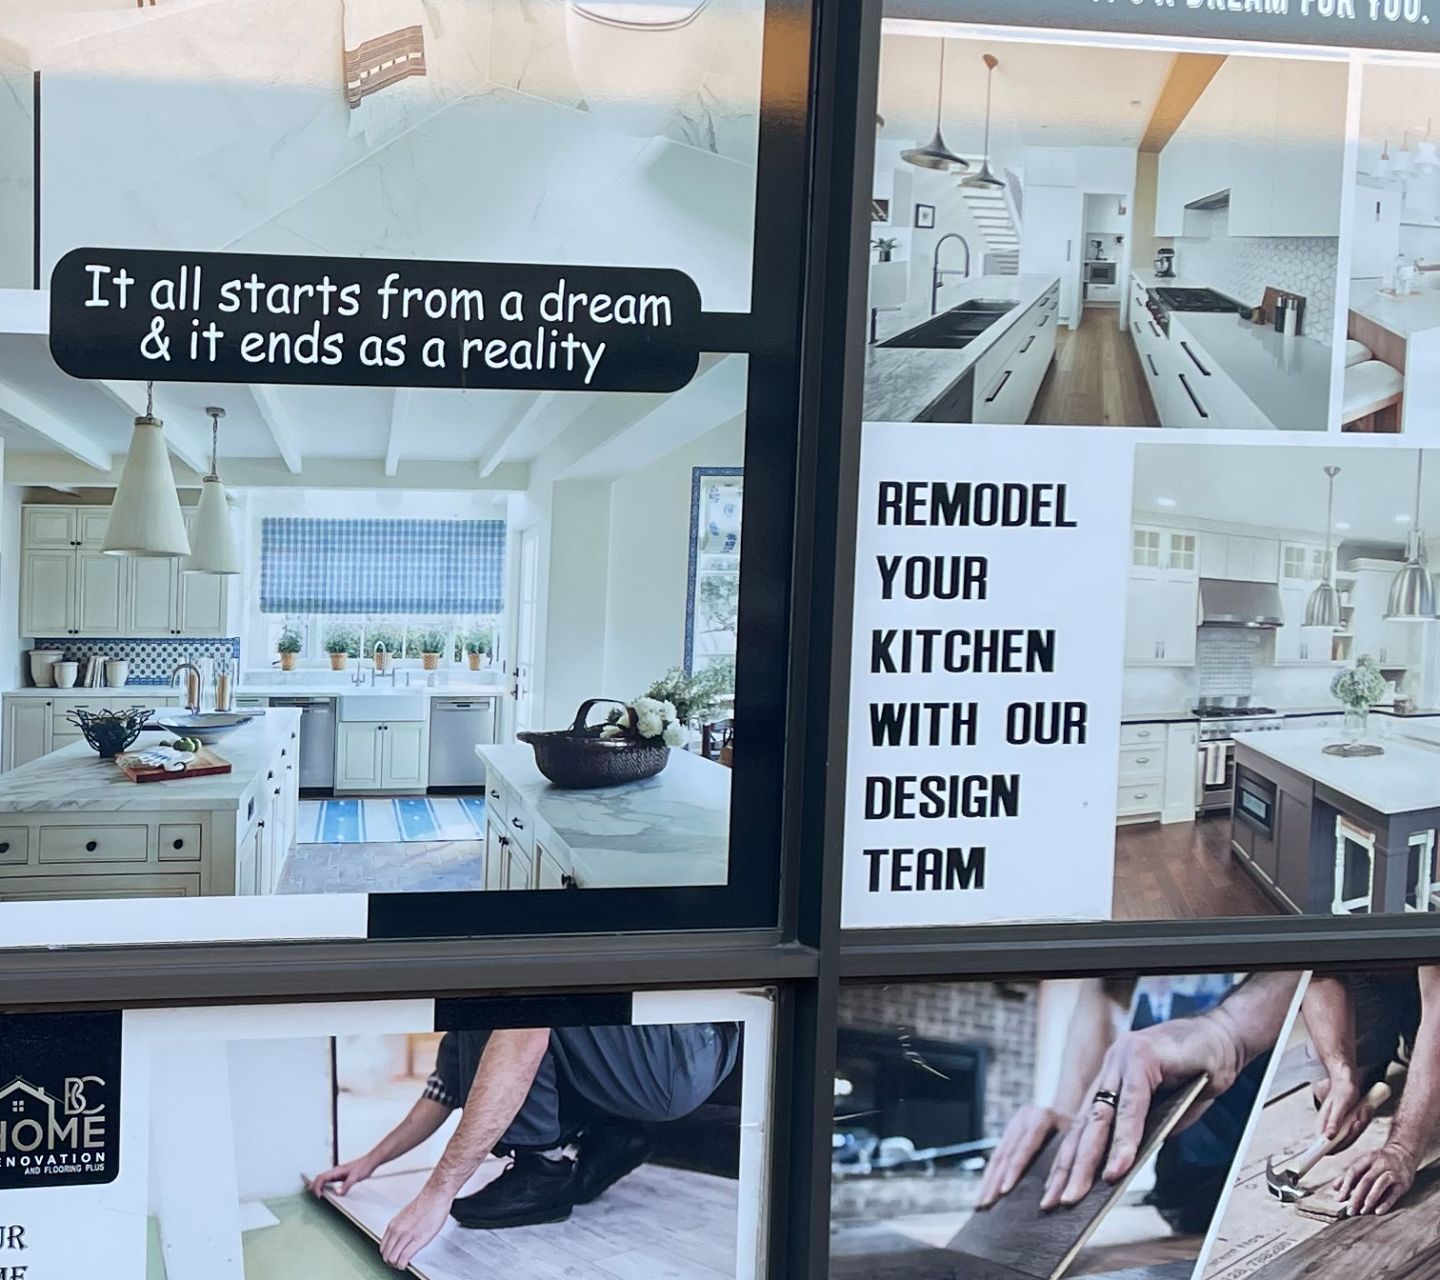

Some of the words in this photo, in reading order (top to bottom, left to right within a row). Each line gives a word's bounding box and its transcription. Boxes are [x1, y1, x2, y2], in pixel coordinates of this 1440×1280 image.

[84, 263, 135, 309] It
[150, 265, 201, 311] all
[218, 274, 361, 316] starts
[377, 273, 485, 320] from
[501, 290, 524, 321] a
[539, 279, 673, 326] dream
[140, 317, 171, 361] &
[190, 318, 225, 361] it
[240, 320, 343, 366] ends
[360, 334, 407, 367] as
[422, 337, 446, 368] a
[462, 326, 606, 384] reality
[877, 480, 1078, 528] REMODEL
[876, 555, 989, 600] YOUR
[871, 629, 1056, 673] KITCHEN
[869, 702, 978, 747] WITH
[1005, 701, 1088, 745] OUR
[864, 774, 1020, 820] DESIGN
[863, 846, 986, 892] TEAM
[24, 1166, 40, 1175] AND
[44, 1164, 82, 1174] FLOORING
[85, 1163, 105, 1172] PLUS
